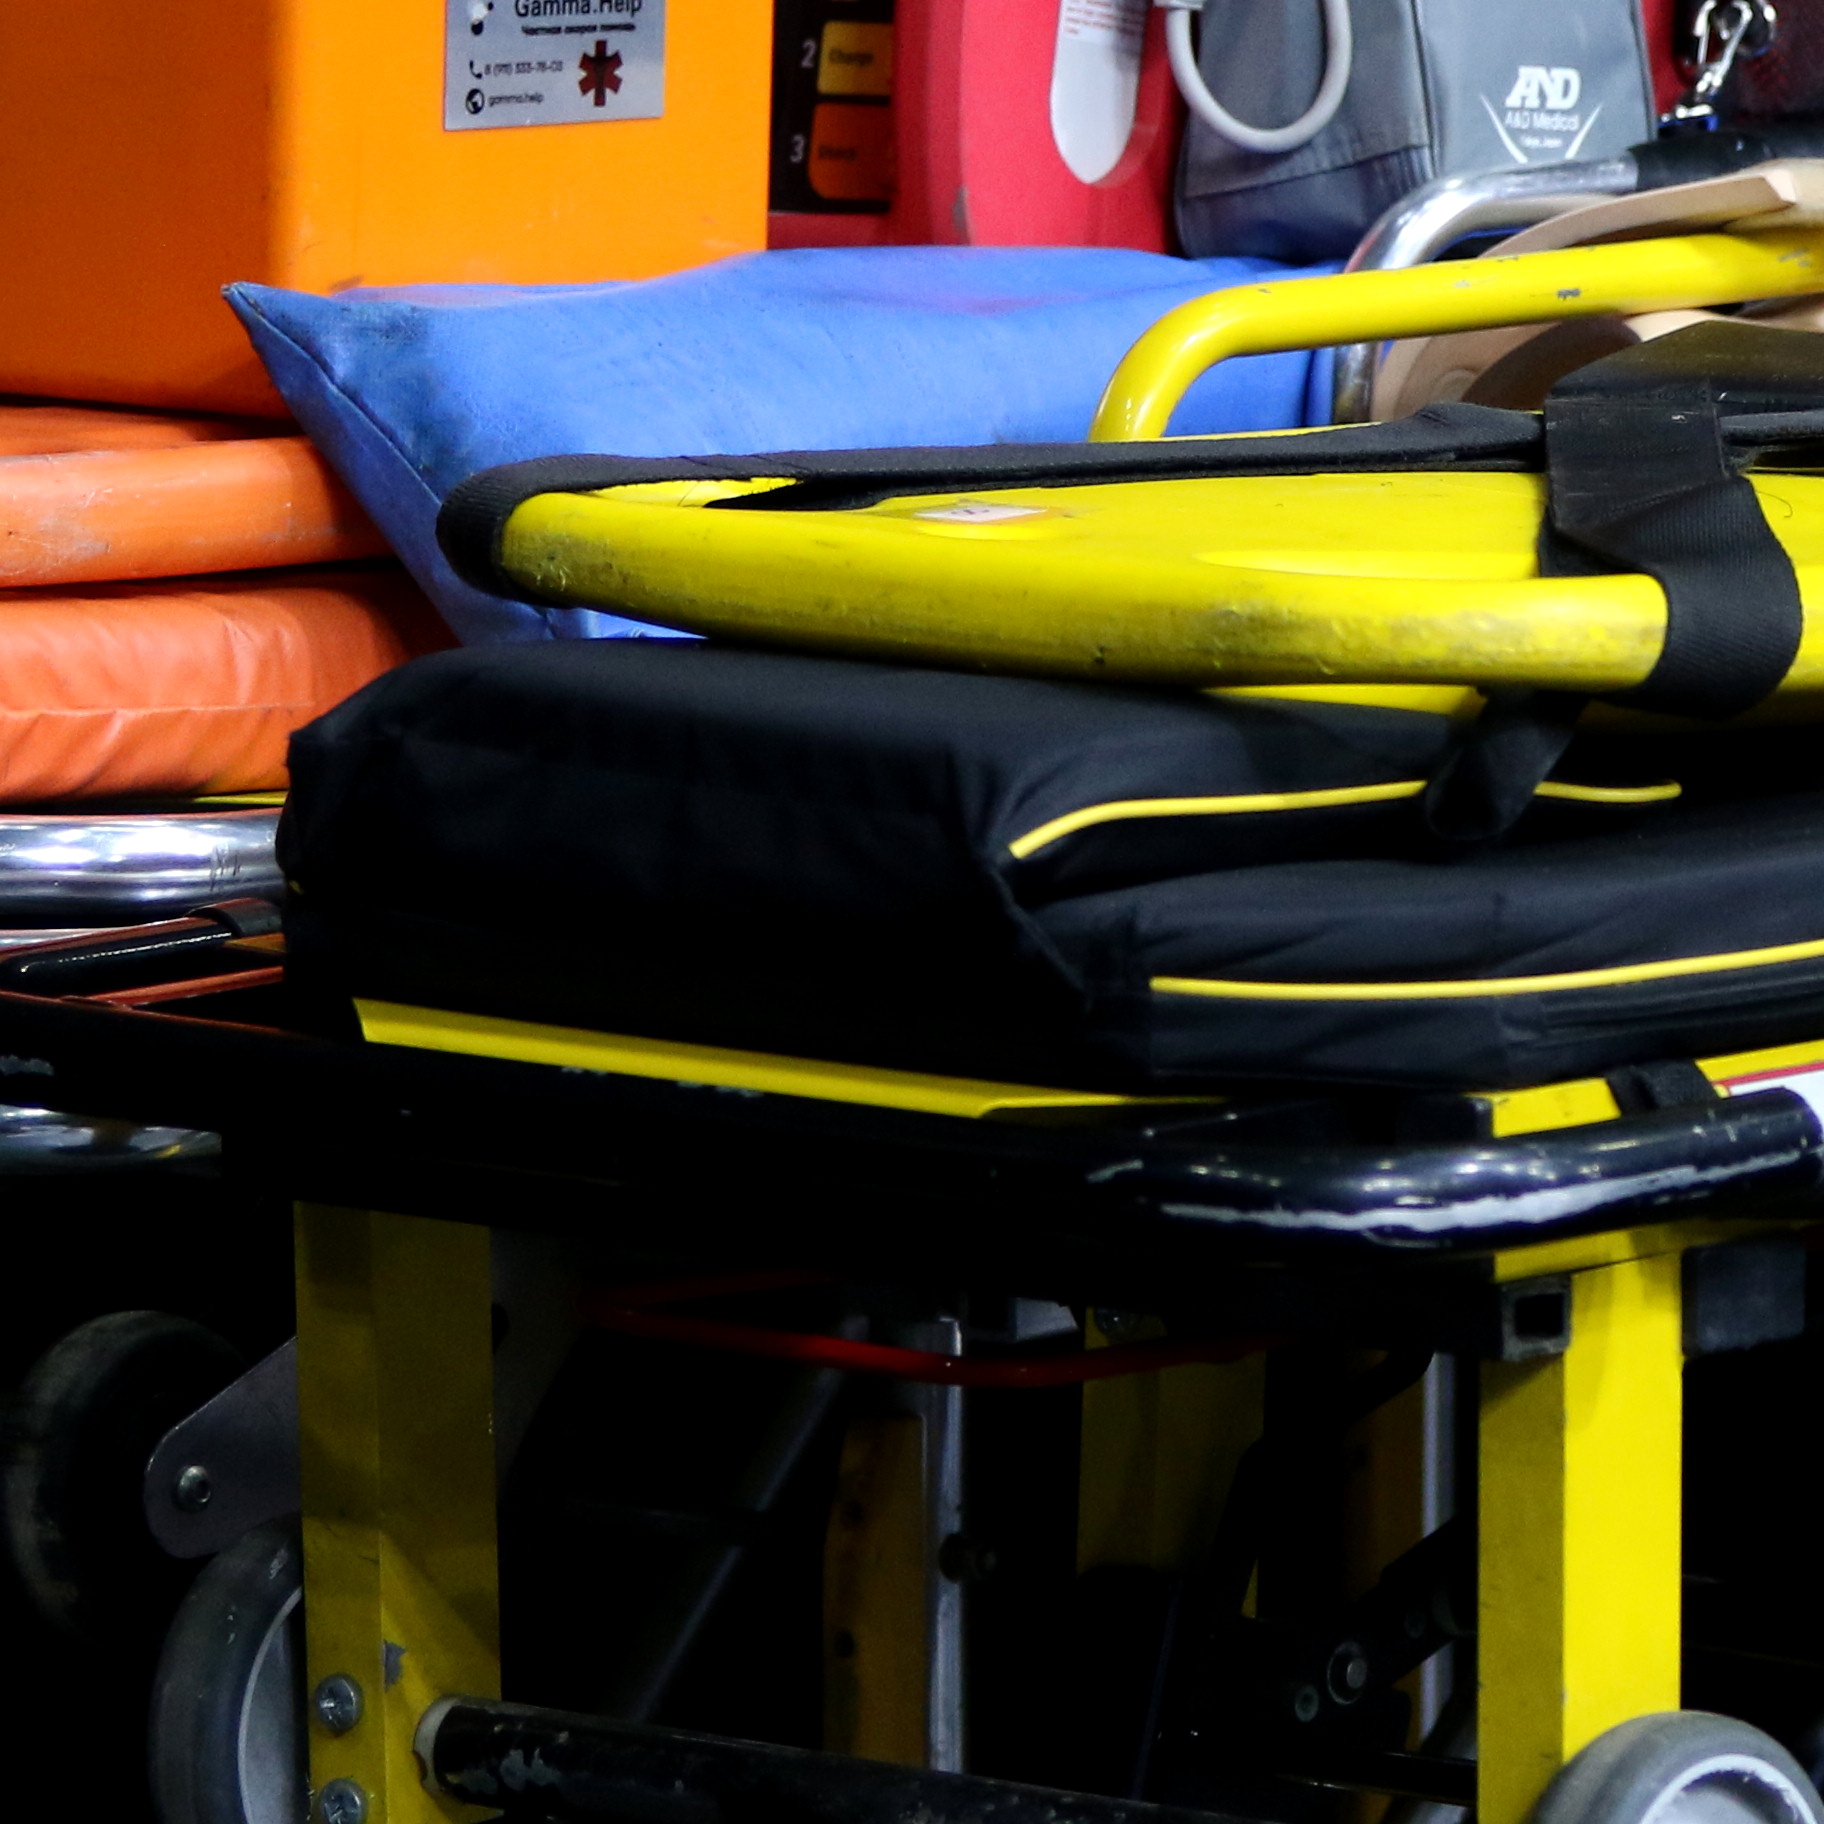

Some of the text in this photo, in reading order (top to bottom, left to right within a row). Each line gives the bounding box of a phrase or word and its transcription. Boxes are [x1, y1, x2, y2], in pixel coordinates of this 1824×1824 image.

[801, 39, 816, 68] 2
[1533, 111, 1580, 132] Medical
[790, 135, 805, 163] 3
